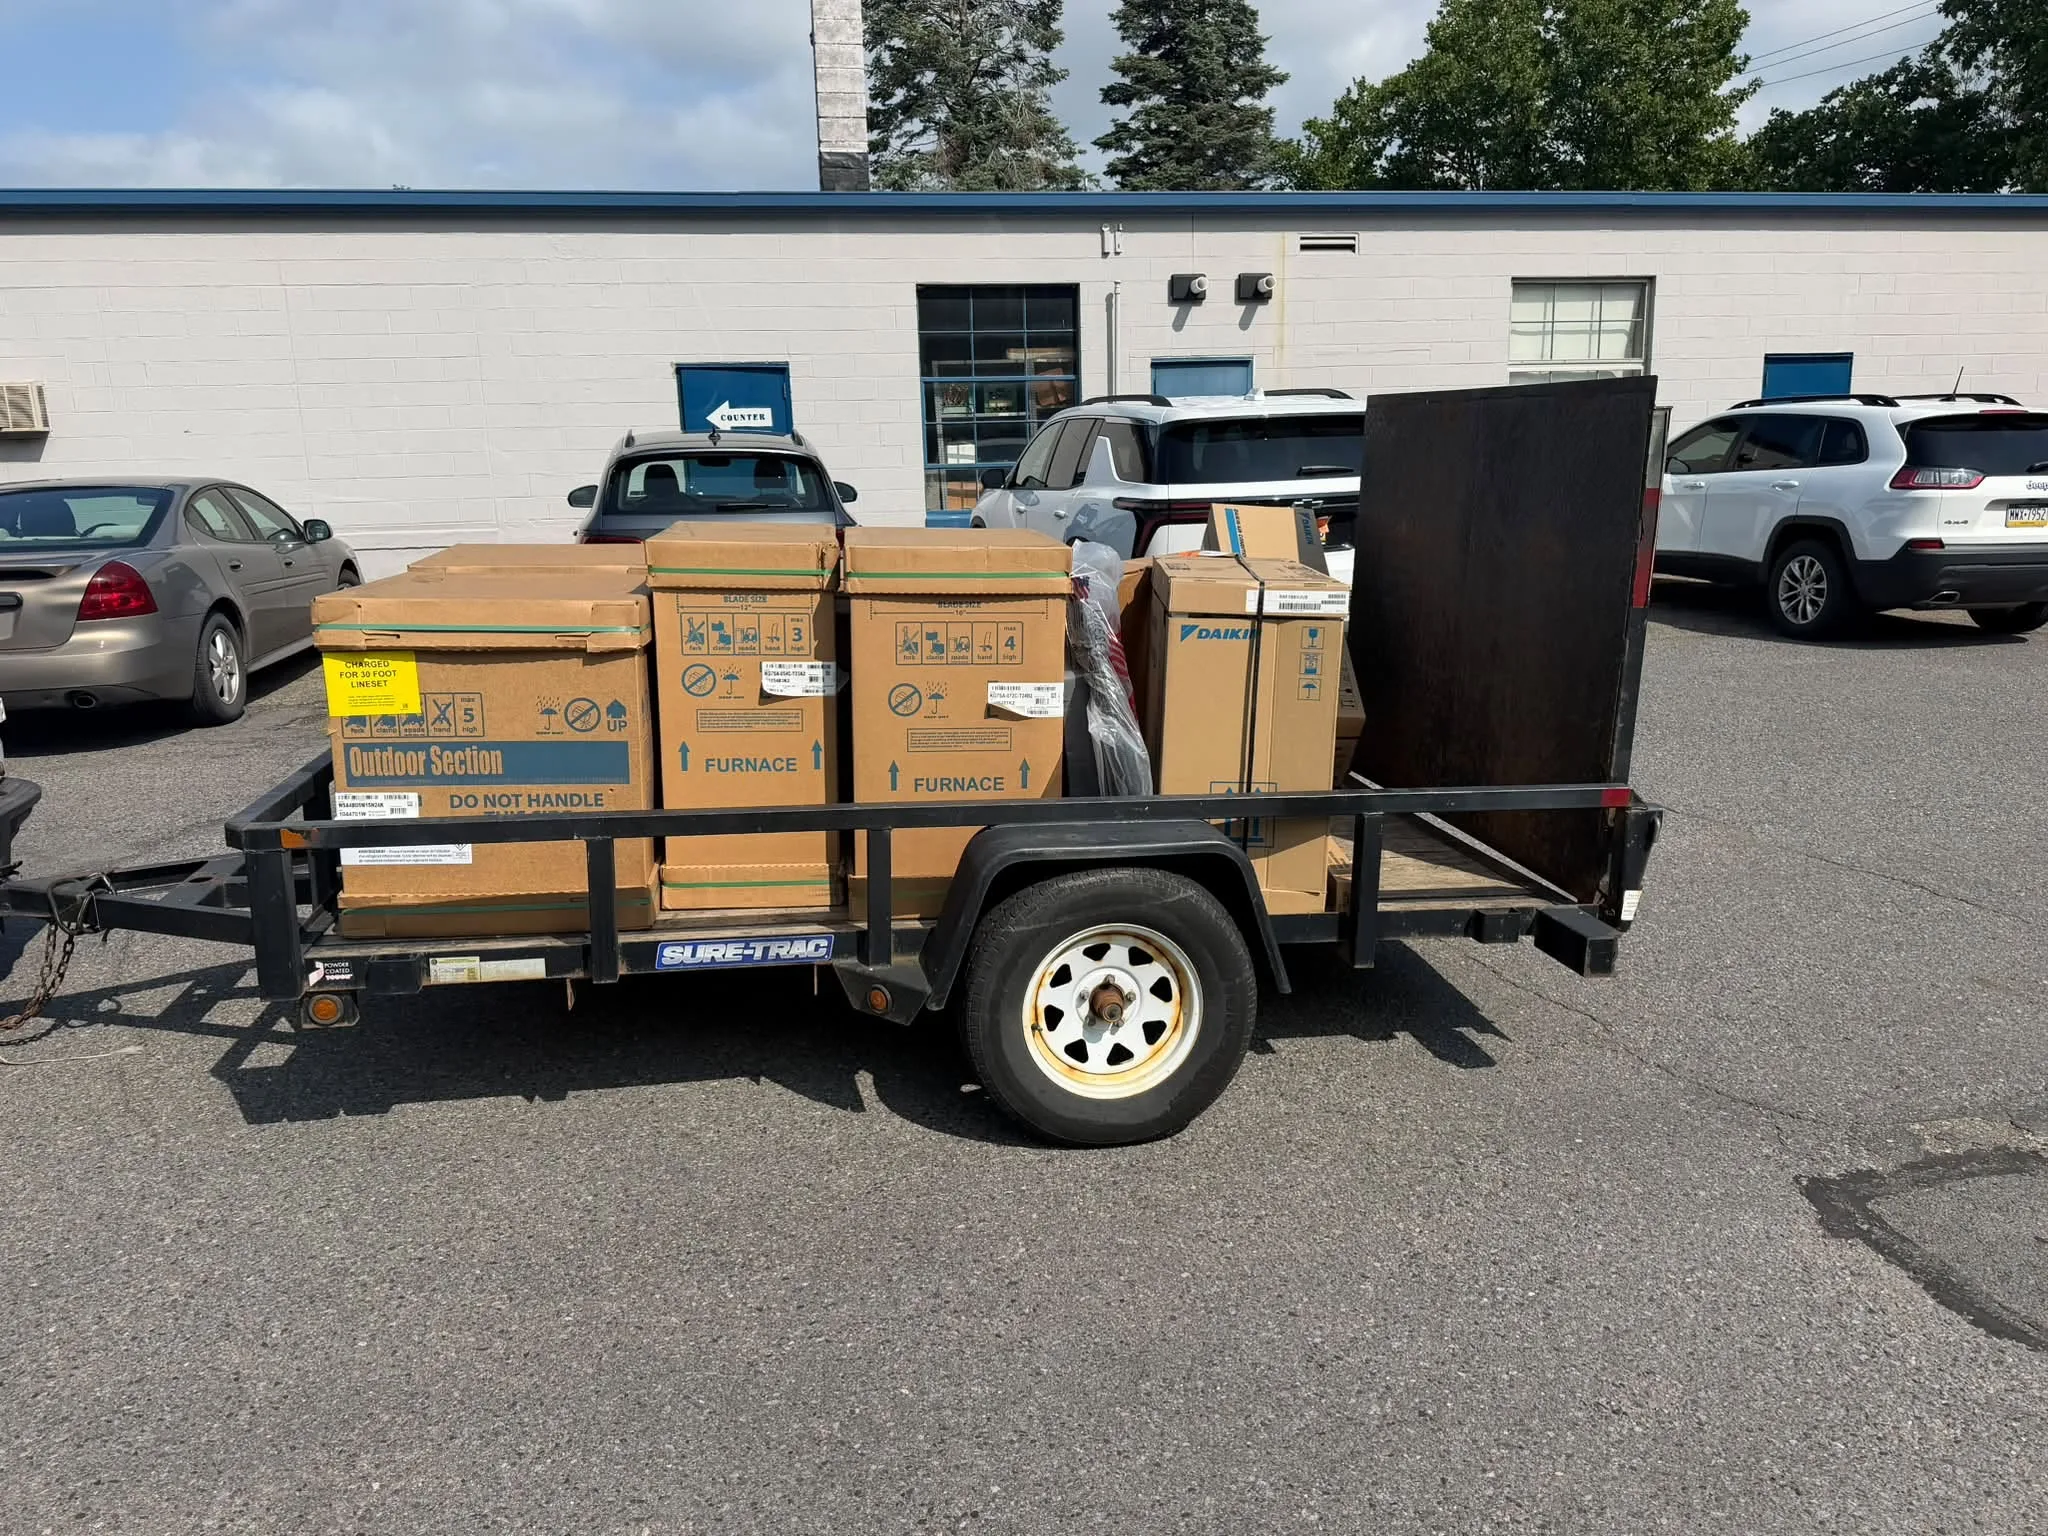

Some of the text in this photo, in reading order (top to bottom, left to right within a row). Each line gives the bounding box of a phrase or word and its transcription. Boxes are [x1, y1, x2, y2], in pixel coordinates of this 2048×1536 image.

[720, 413, 766, 421] COUNTER
[792, 628, 803, 642] 3
[1004, 636, 1016, 650] 4
[345, 660, 390, 669] CHARGED
[339, 669, 397, 679] FOR 30 FOOT
[351, 680, 388, 688] LINESET
[463, 708, 475, 723] 5
[607, 719, 628, 733] UP
[350, 744, 504, 777] Outdoor Section
[705, 757, 798, 773] FURNACE
[914, 776, 1005, 792] FURNACE
[449, 792, 604, 809] DO NOT HANDLE
[661, 939, 828, 965] SURE-TRAC
